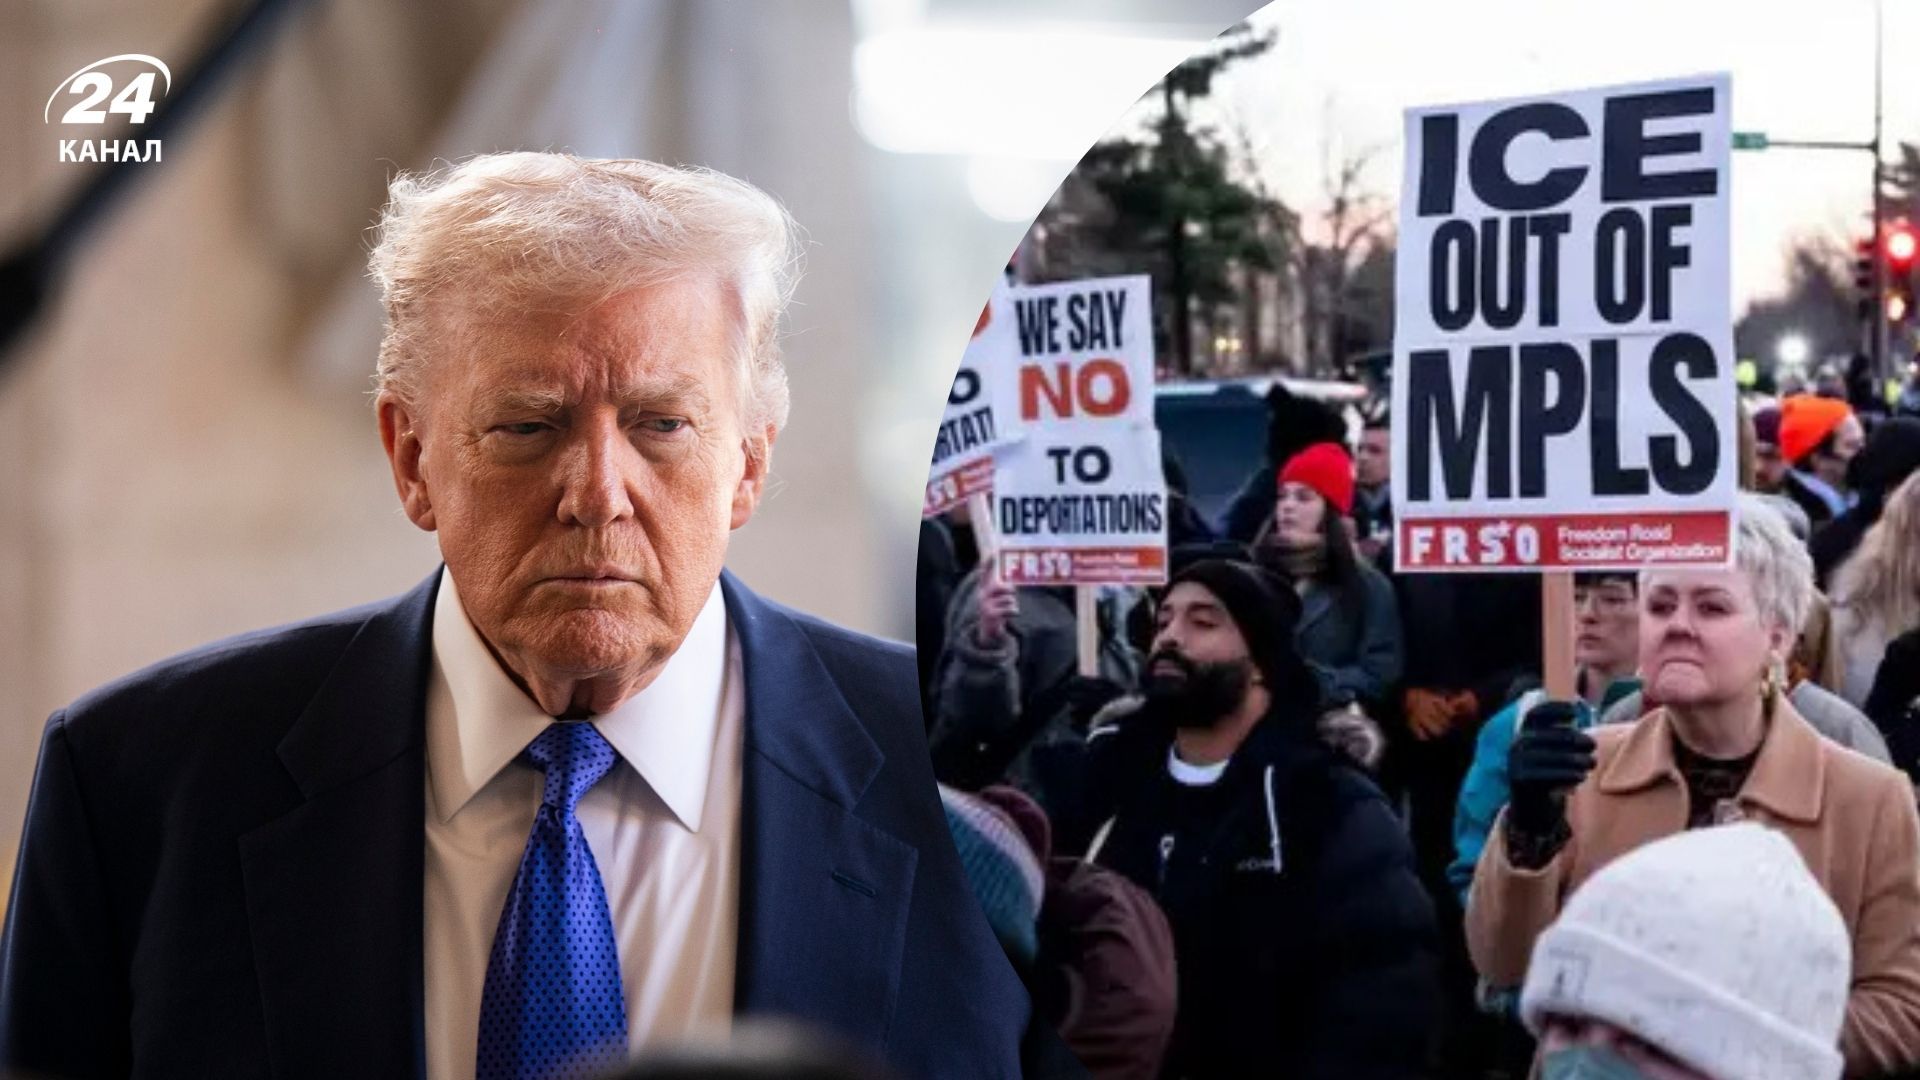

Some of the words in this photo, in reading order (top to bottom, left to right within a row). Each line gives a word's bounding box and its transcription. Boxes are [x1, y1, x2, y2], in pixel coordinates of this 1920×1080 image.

[1417, 87, 1718, 217] ICE
[1429, 213, 1571, 331] OUT
[1595, 204, 1692, 324] OF
[1015, 297, 1060, 356] WE
[1066, 290, 1126, 352] SAY
[1019, 358, 1131, 421] NO
[1407, 332, 1719, 502] MPLS
[1047, 446, 1111, 484] TO
[1001, 493, 1162, 535] DEPORTATIONS
[1410, 521, 1540, 564] FRSO
